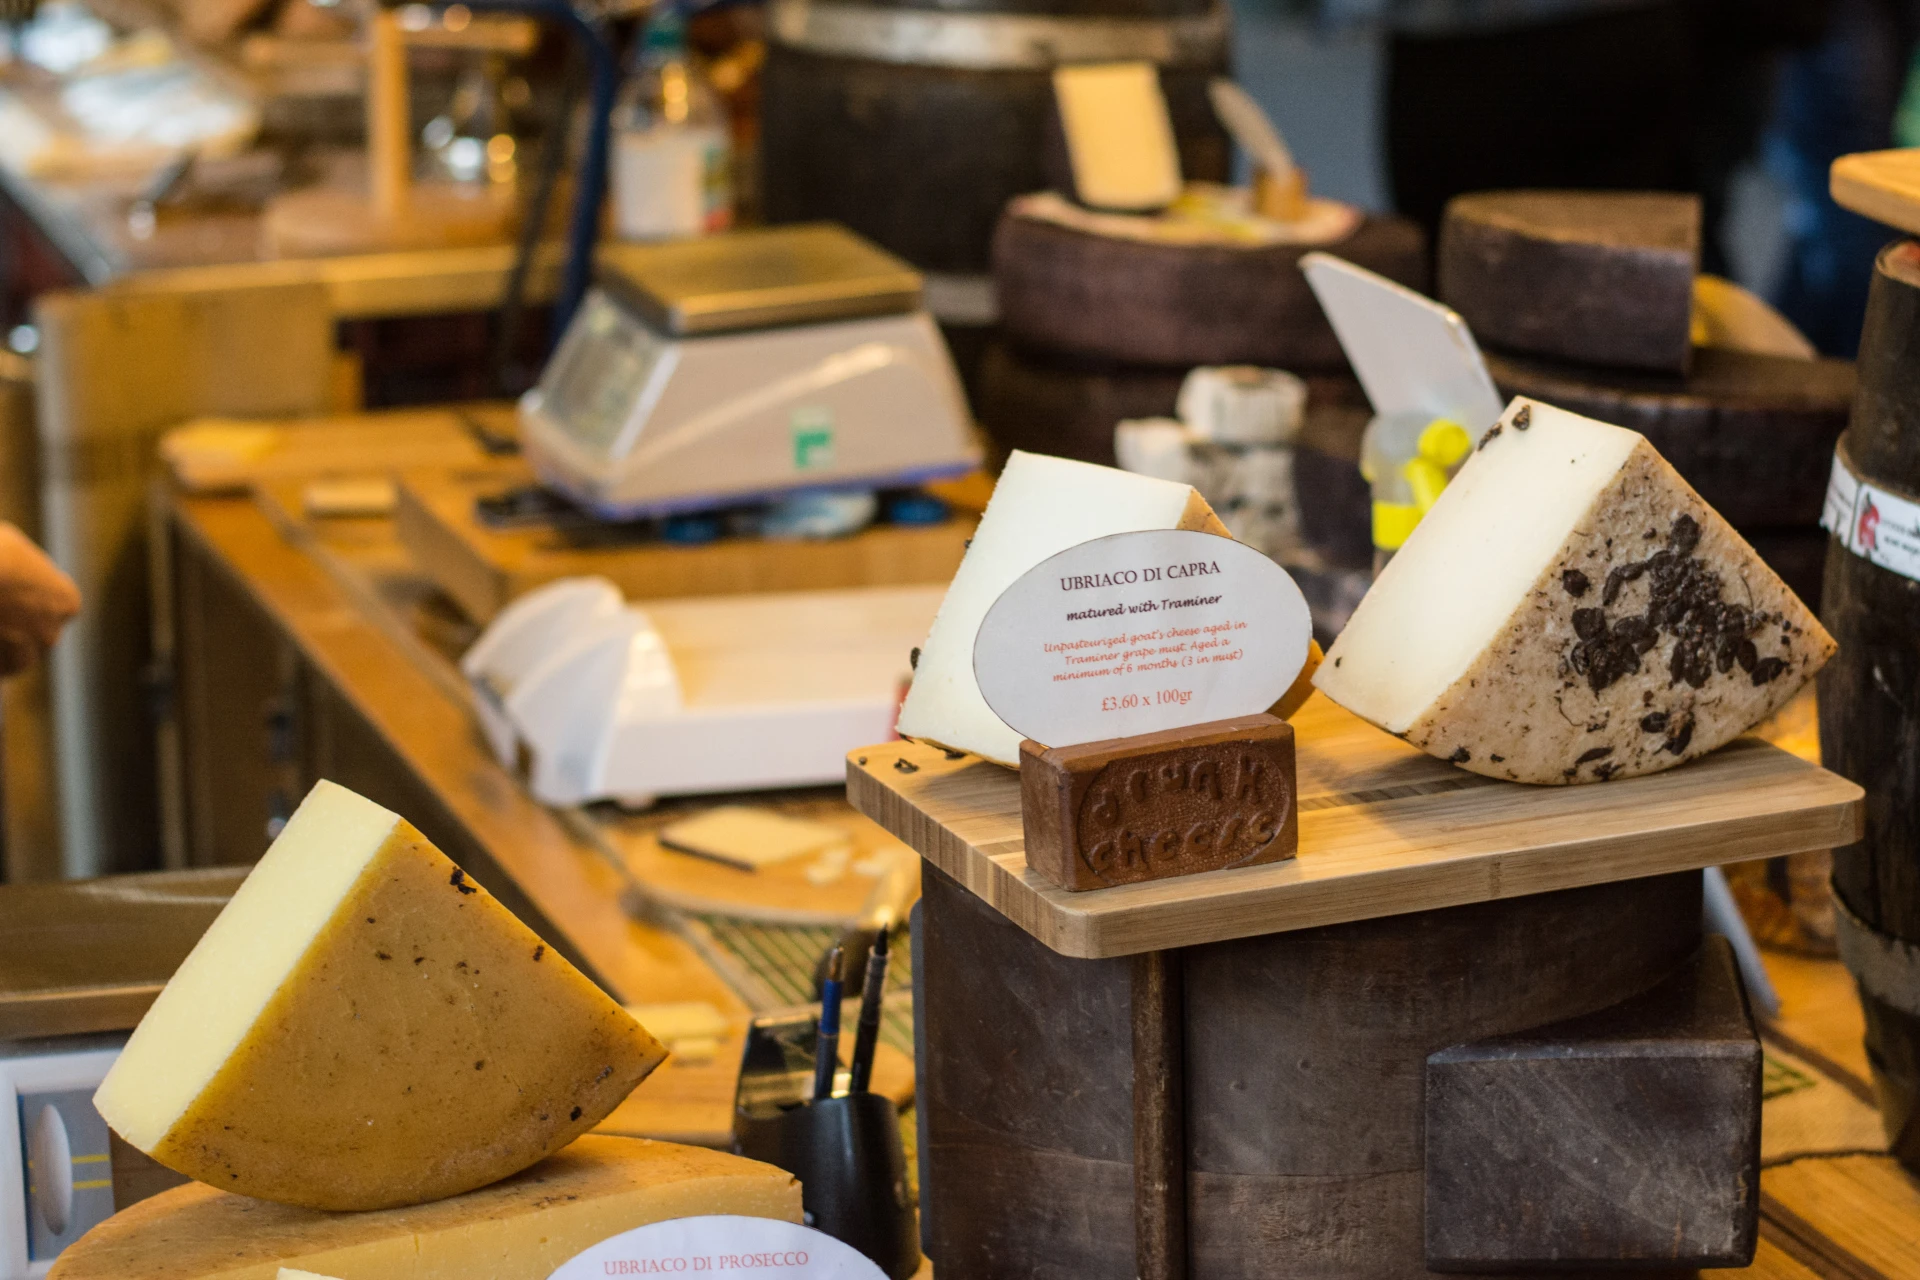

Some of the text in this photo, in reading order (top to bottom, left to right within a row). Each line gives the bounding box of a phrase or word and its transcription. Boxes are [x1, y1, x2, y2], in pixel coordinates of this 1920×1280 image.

[1060, 560, 1221, 591] UBRIACO DI CAPRA
[1066, 594, 1223, 621] matured with Traminer
[1044, 620, 1248, 654] Unpasteurized goat's cheese aged in
[1065, 652, 1120, 667] Traminer
[1122, 647, 1156, 662] grape
[1190, 637, 1219, 652] Aged
[1221, 638, 1231, 646] a
[1053, 648, 1244, 682] minimum of 6 months (3 in must)
[1101, 688, 1193, 711] £3.60 x 100gr
[603, 1251, 809, 1276] UBRIACO DI PROSECCO
